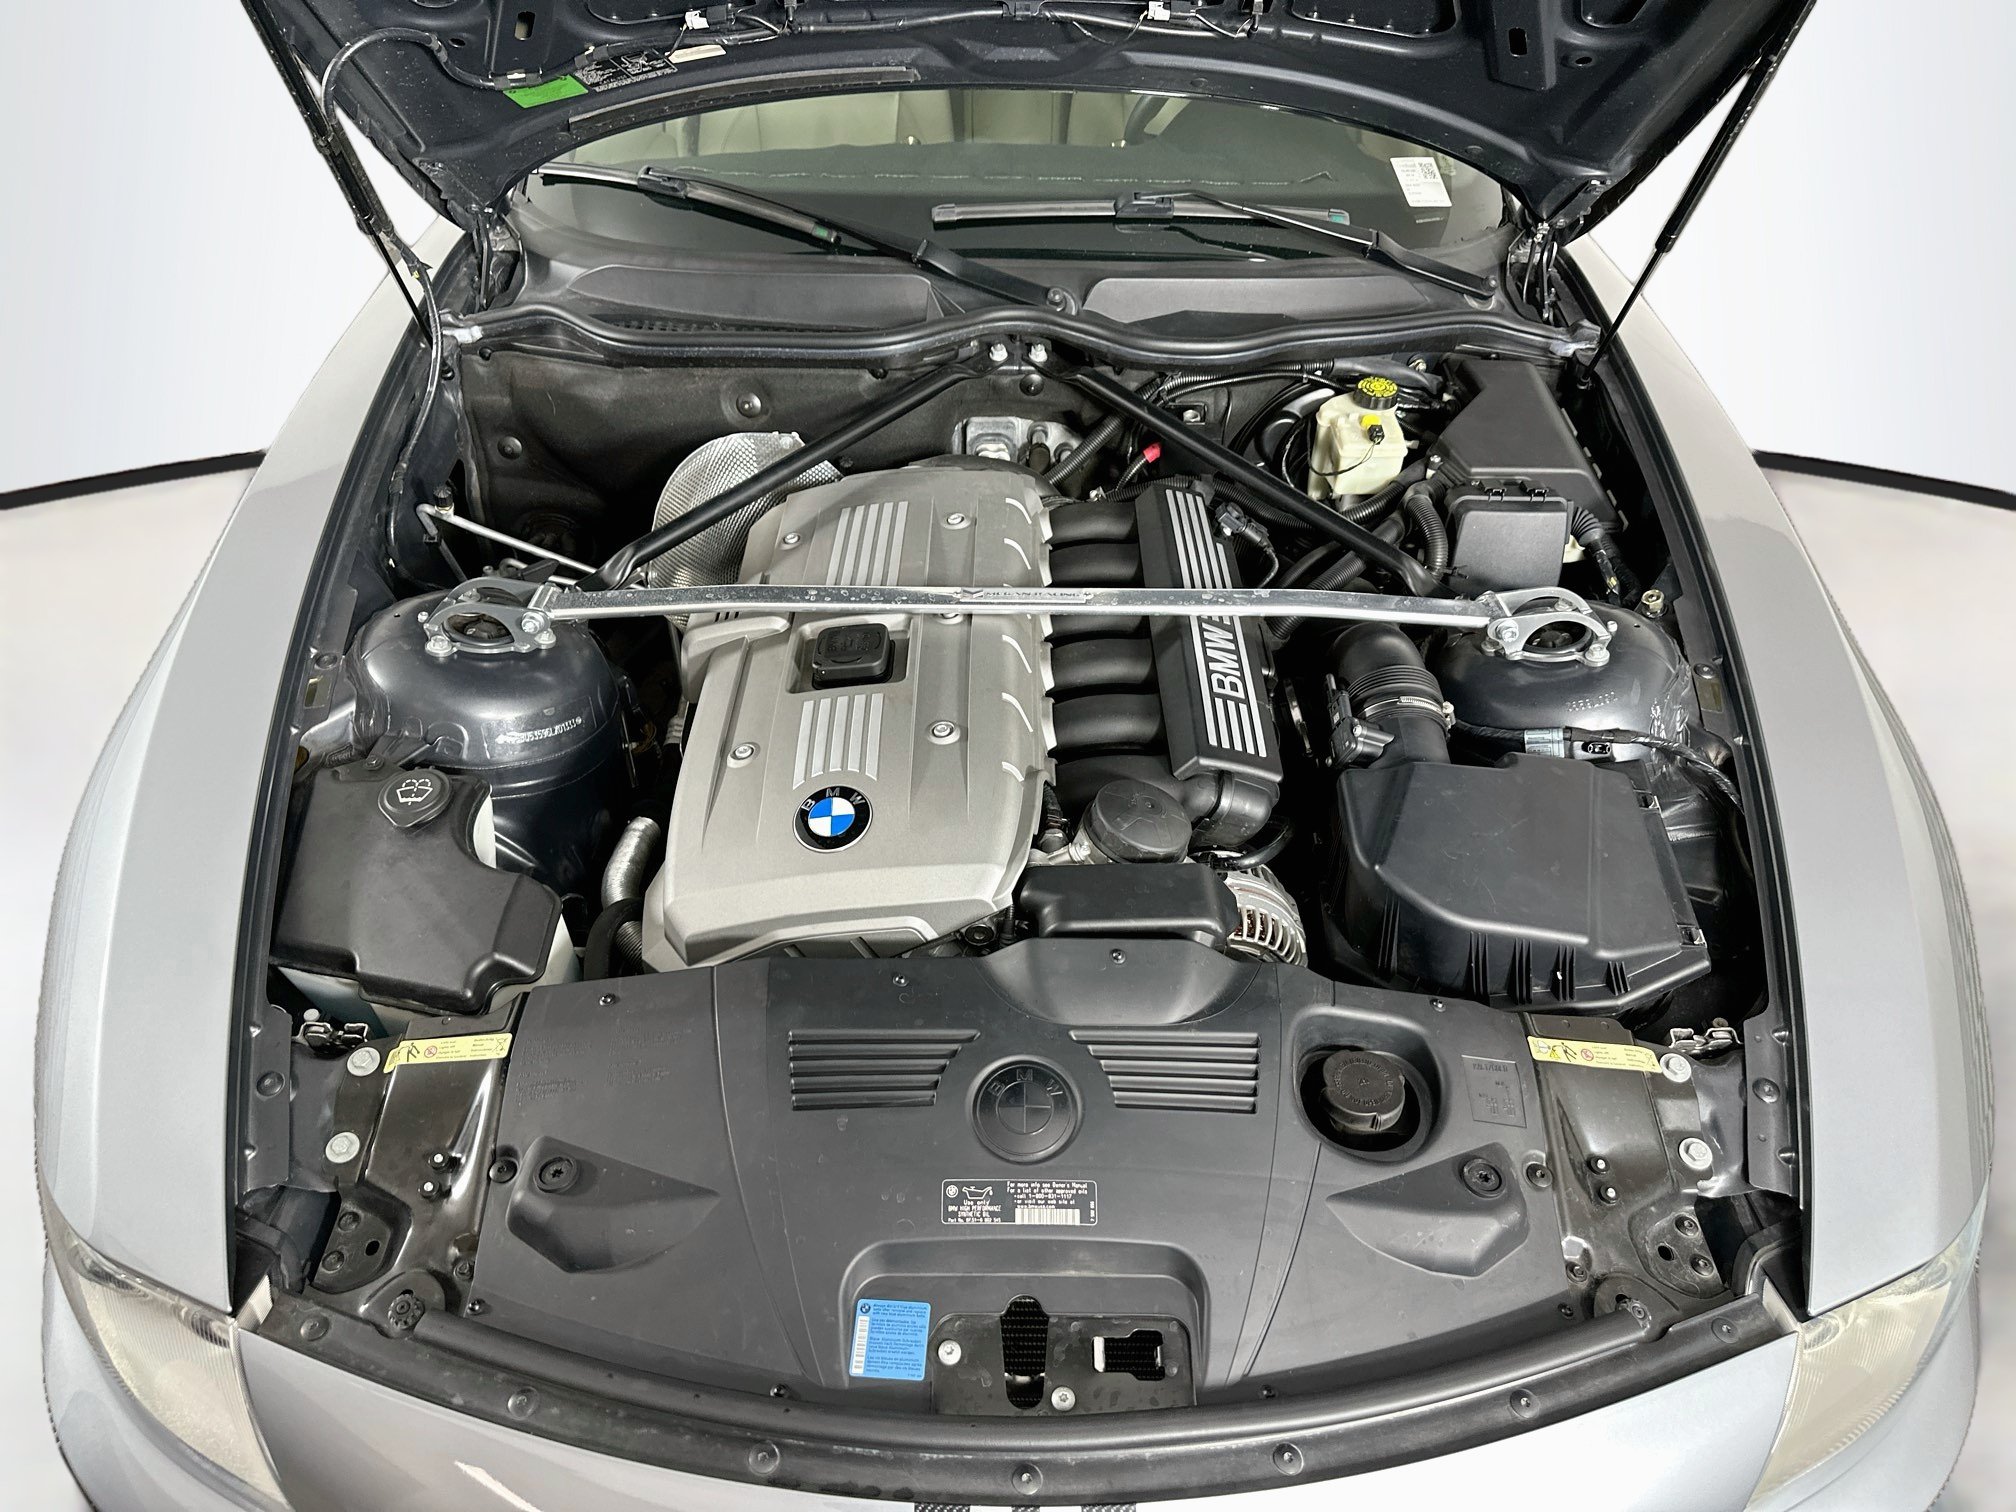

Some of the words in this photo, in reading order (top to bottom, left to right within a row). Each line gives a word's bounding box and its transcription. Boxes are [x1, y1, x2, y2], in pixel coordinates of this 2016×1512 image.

[1201, 622, 1245, 699] BMW
[801, 787, 866, 812] BMW
[988, 1069, 1063, 1097] BMW
